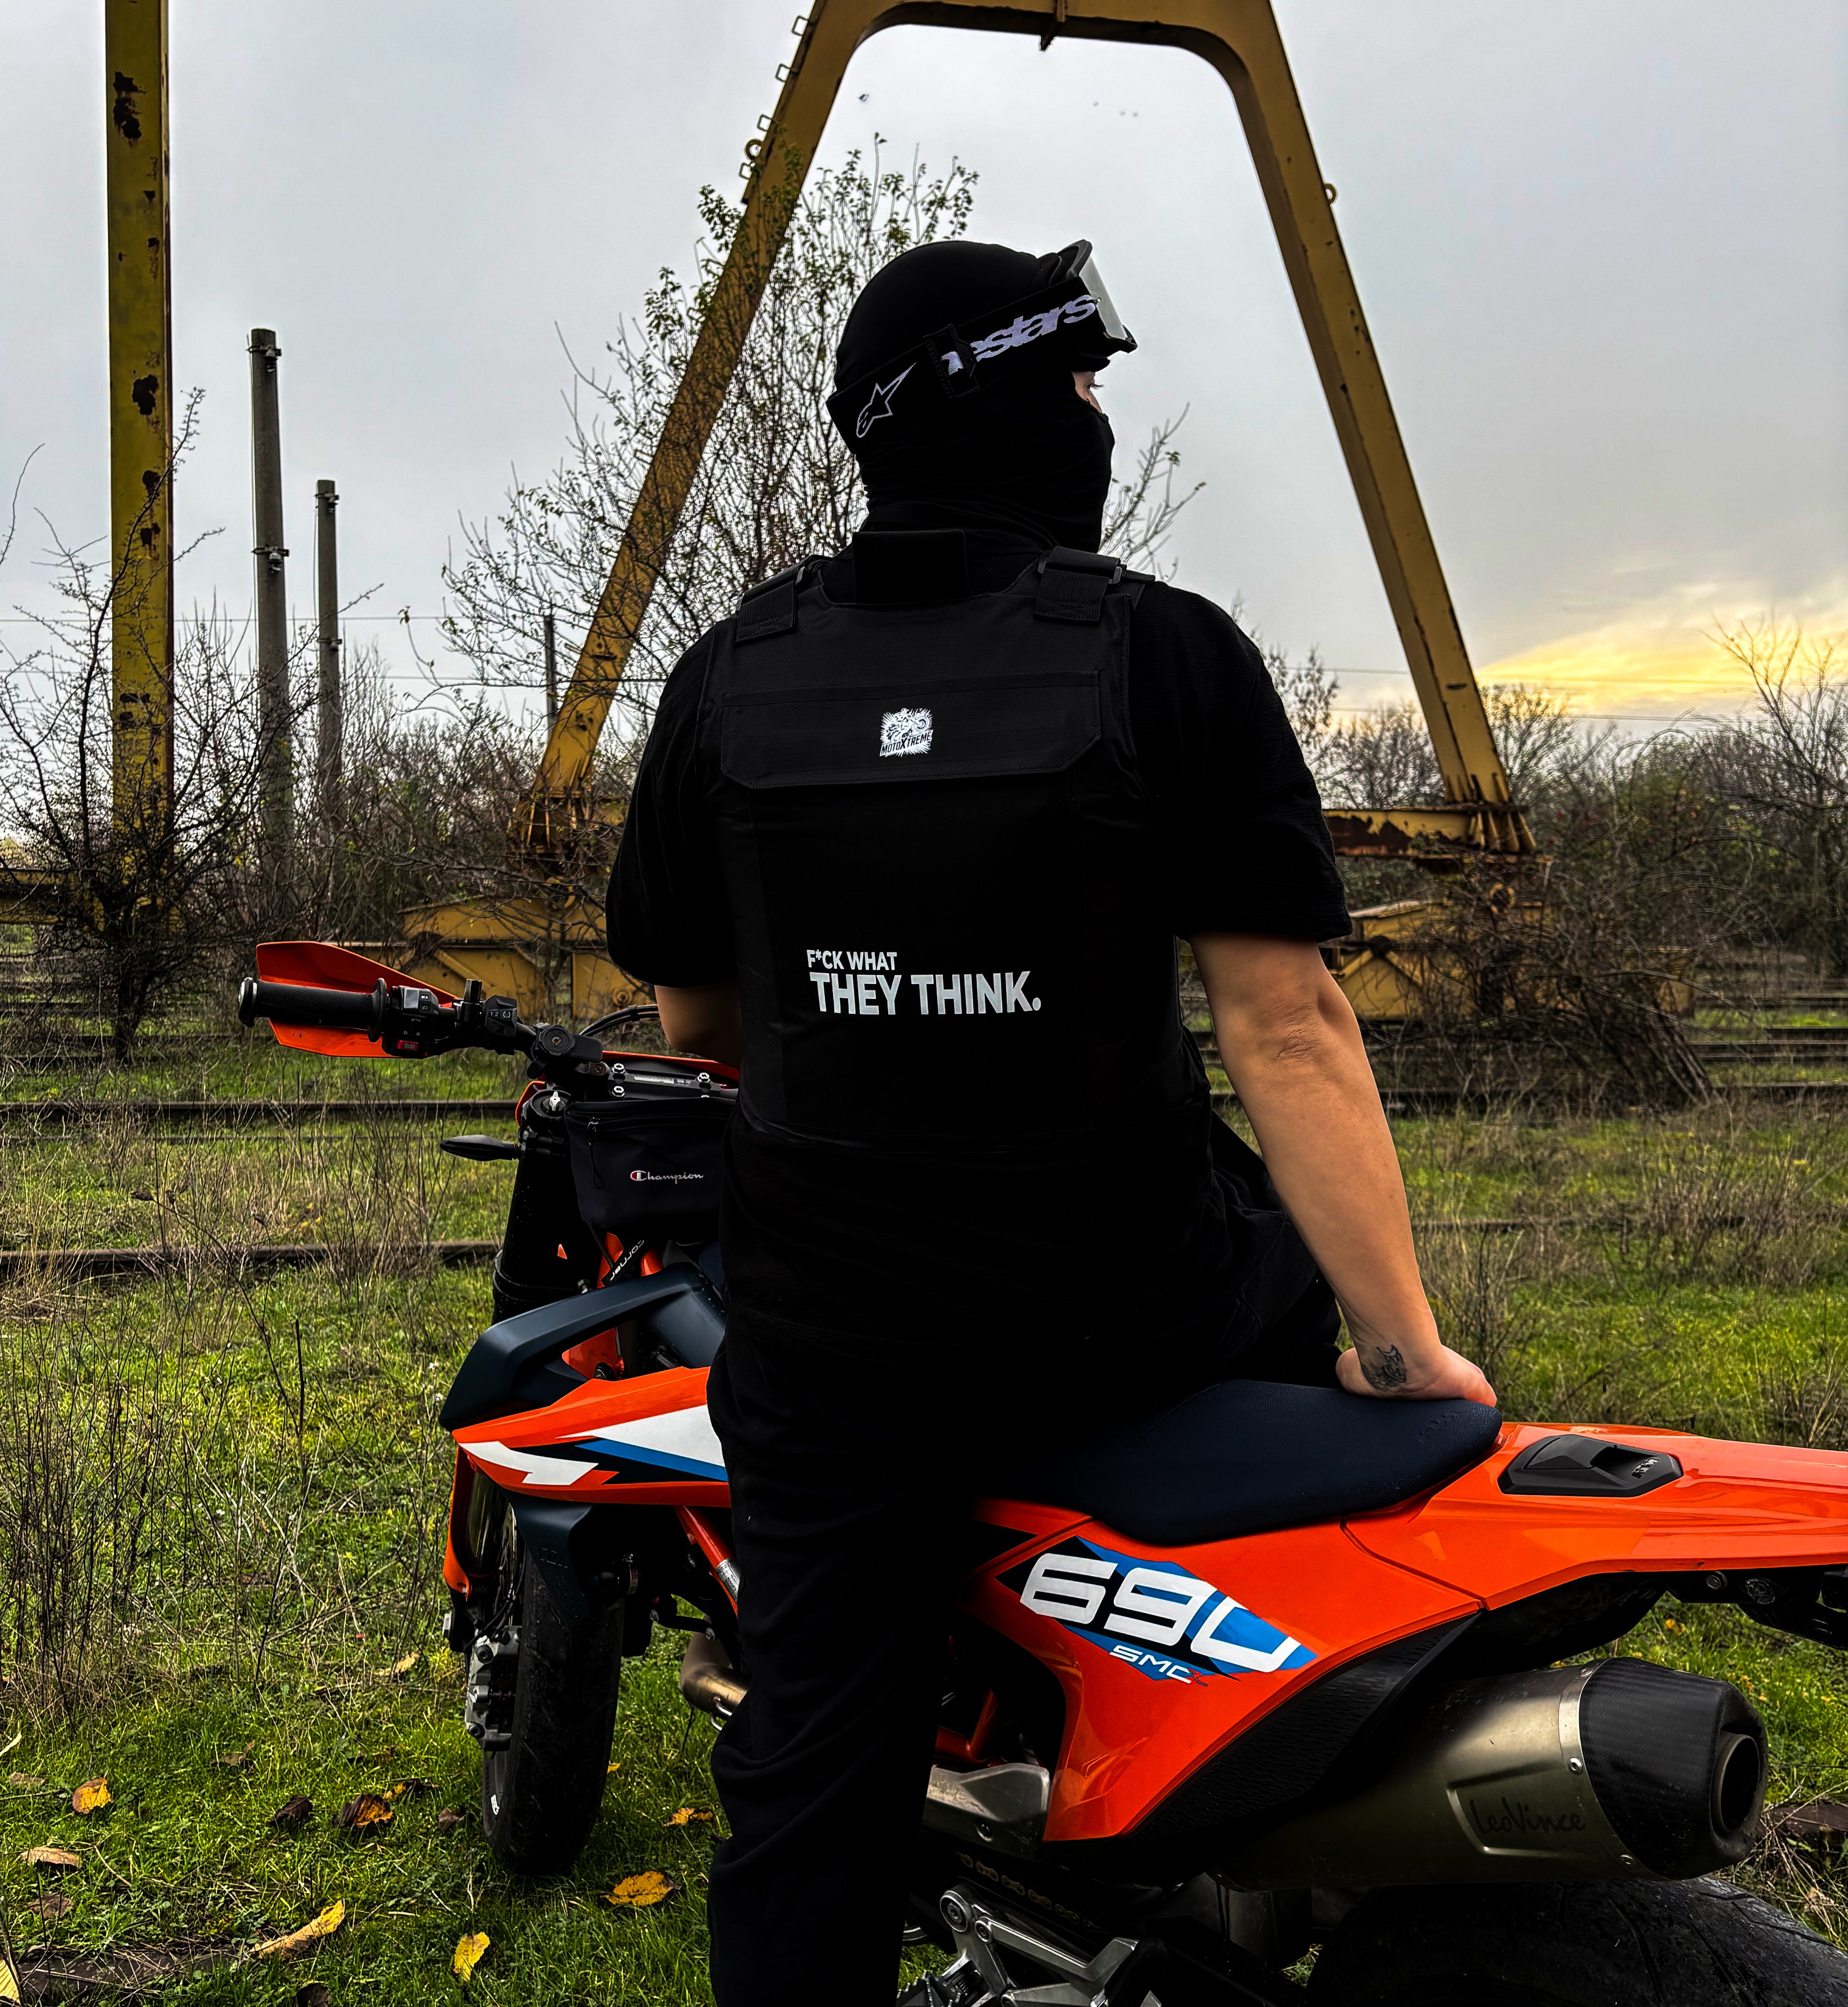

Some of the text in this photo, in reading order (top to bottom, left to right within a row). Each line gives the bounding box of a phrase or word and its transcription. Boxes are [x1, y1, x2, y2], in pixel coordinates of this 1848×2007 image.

[847, 952, 897, 970] WHAT
[809, 971, 1041, 1015] THEY THINK.
[630, 1170, 704, 1184] Champion
[1020, 1553, 1301, 1672] 690
[1470, 1797, 1585, 1834] LeoVince
